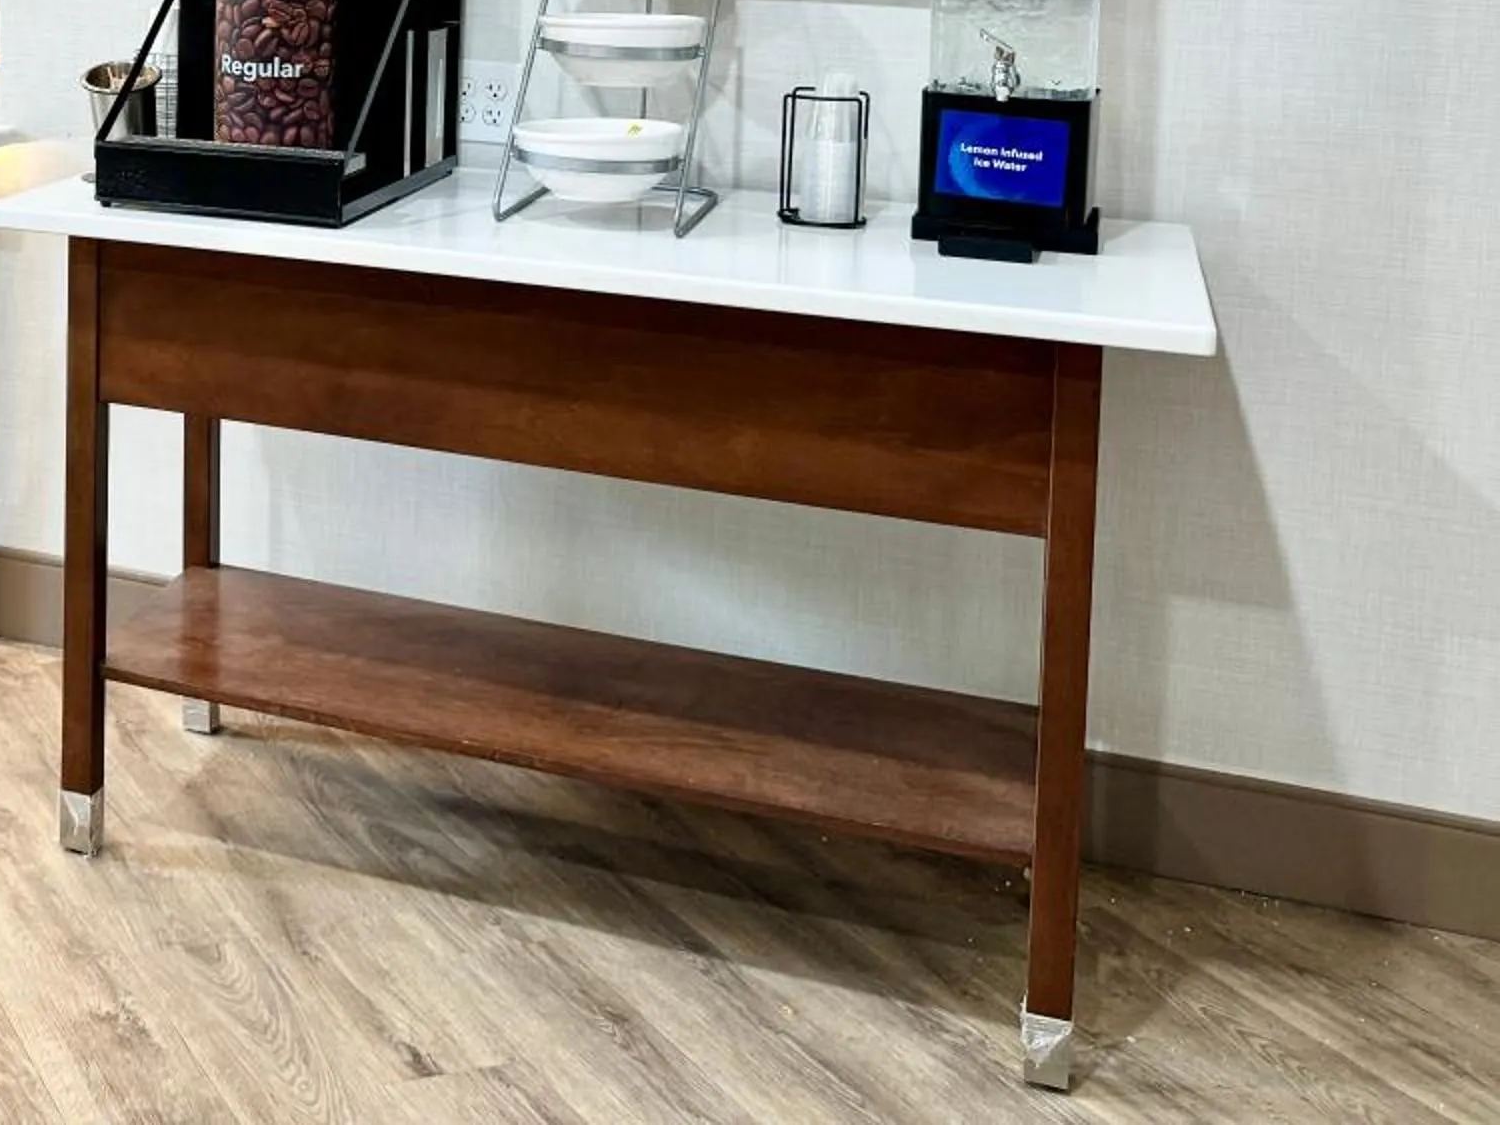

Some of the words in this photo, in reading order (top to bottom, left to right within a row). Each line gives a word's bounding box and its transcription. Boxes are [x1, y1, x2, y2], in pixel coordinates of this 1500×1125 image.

[221, 54, 304, 81] Regular
[960, 143, 998, 156] Lemon
[1000, 147, 1043, 162] Infused
[973, 157, 991, 168] Ice
[992, 159, 1027, 172] Water
